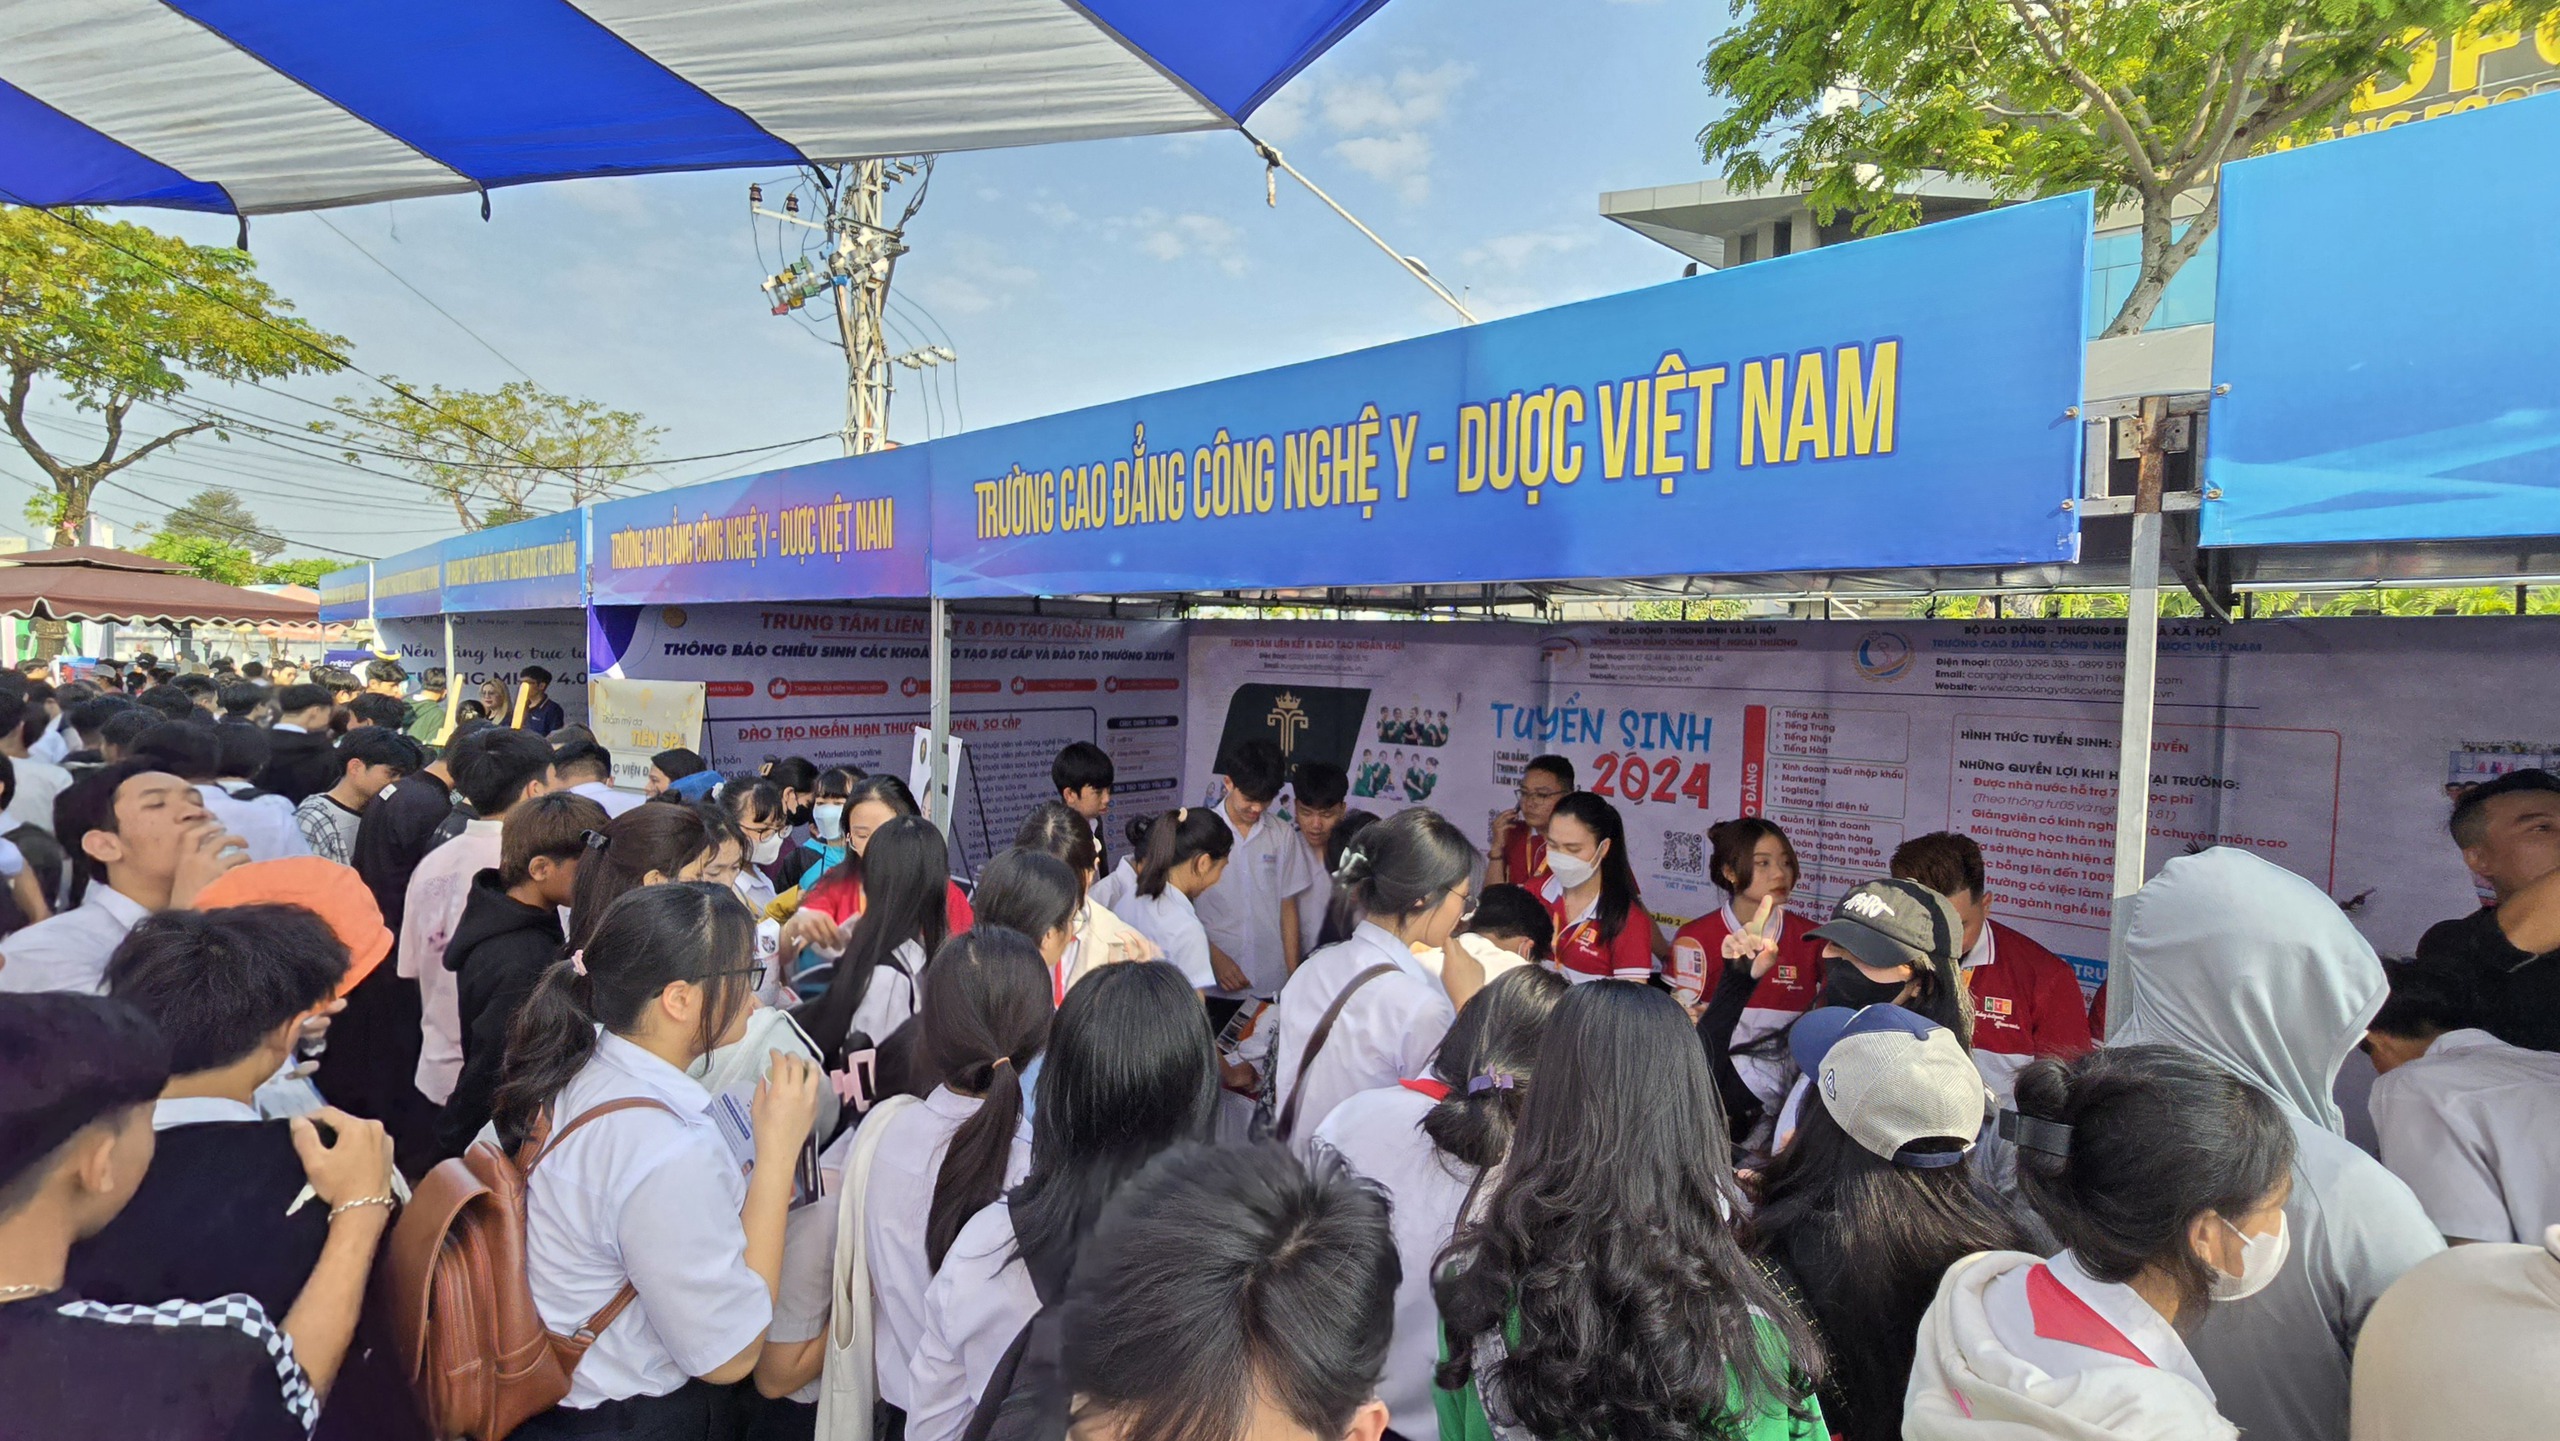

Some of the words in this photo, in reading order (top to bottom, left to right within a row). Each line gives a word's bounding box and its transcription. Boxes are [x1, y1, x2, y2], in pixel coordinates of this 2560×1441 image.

[974, 465, 1055, 539] TRƯỜNG
[1060, 464, 1106, 531] CAO
[1113, 423, 1185, 526] ĐẲNG
[1194, 430, 1275, 518] CÔNG
[1284, 405, 1380, 519] NGHỆ
[1390, 415, 1418, 499] Y
[1428, 446, 1445, 461] -
[1458, 387, 1583, 505] DƯỢC
[1598, 353, 1725, 494] VIỆT
[1740, 340, 1897, 466] NAM
[611, 524, 643, 569] TRƯỜNG
[646, 526, 663, 567] CAO
[665, 505, 693, 565] ĐẲNG
[695, 512, 723, 562] CÔNG
[726, 506, 757, 567] NGHỆ
[760, 512, 769, 558] Y
[780, 505, 816, 565] DƯỢC
[819, 494, 852, 562] VIỆT
[855, 497, 893, 550] NAM
[761, 612, 833, 631] TRUNG
[839, 613, 881, 632] TÂM
[884, 615, 925, 633] LIÊN
[965, 621, 976, 635] &
[1984, 626, 2006, 634] LAO
[2057, 625, 2110, 635] THƯƠNG
[1980, 639, 2007, 648] CAO
[2051, 638, 2088, 649] CÔNG
[402, 643, 436, 658] Nền
[454, 646, 486, 664] ảng
[494, 646, 523, 662] học
[664, 642, 727, 656] THÔNG
[731, 642, 768, 657] BÁO
[772, 643, 817, 658] CHIÊU
[820, 646, 857, 658] SINH
[859, 643, 889, 659] CÁC
[964, 649, 987, 663] TẠO
[1035, 648, 1051, 660] VÀ
[1052, 648, 1076, 661] ĐÀO
[1078, 650, 1099, 664] TẠO
[1993, 659, 2023, 668] (0236)
[557, 672, 588, 685] 4.0
[1935, 671, 1965, 679] Email:
[1935, 682, 1977, 691] Website:
[1490, 691, 1605, 745] TUYỂN
[1619, 707, 1712, 752] SINH
[1785, 710, 1808, 720] Tiếng
[1811, 711, 1829, 720] Anh
[738, 726, 772, 741] ĐÀO
[776, 727, 805, 742] TẠO
[809, 719, 849, 737] NGẮN
[853, 723, 881, 739] HẠN
[1784, 721, 1808, 731] Tiếng
[1810, 723, 1835, 733] Trung
[1784, 732, 1807, 742] Tiếng
[1810, 734, 1831, 743] Nhật
[1961, 730, 1991, 741] HÌNH
[1995, 731, 2029, 742] THỨC
[2033, 732, 2072, 745] TUYỂN
[2077, 738, 2112, 748] SINH:
[1783, 743, 1807, 754] Tiếng
[1809, 745, 1828, 754] Hàn
[1781, 774, 1827, 786] Marketing
[1782, 763, 1800, 772] Kinh
[1802, 764, 1830, 774] doanh
[1832, 765, 1852, 776] xuất
[1854, 769, 1878, 779] nhập
[1959, 760, 2004, 771] NHỮNG
[2009, 761, 2051, 774] QUYỀN
[2056, 766, 2077, 778] LỢI
[2081, 769, 2104, 779] KHI
[2172, 775, 2240, 789] TRƯỜNG:
[1591, 753, 1711, 809] 2024
[1974, 777, 2006, 790] Được
[2008, 780, 2032, 790] nhà
[2035, 781, 2067, 793] nước
[2070, 783, 2087, 795] hỗ
[2089, 787, 2107, 798] trợ
[1781, 785, 1819, 796] Logistics
[1781, 796, 1813, 808] Thương
[1815, 800, 1833, 809] mại
[1835, 801, 1856, 811] điện
[1780, 815, 1804, 824] Quản
[1818, 819, 1837, 828] kinh
[1839, 821, 1870, 831] doanh
[2039, 813, 2055, 825] có
[2058, 816, 2085, 829] kinh
[2163, 827, 2216, 843] chuyên
[2220, 833, 2253, 846] môn
[2256, 838, 2288, 849] cao
[1795, 827, 1820, 837] chính
[1848, 833, 1873, 845] hàng
[1970, 825, 1993, 835] Môi
[1995, 828, 2036, 842] trường
[2038, 831, 2064, 845] học
[2066, 834, 2096, 847] thân
[1815, 841, 1846, 852] doanh
[1848, 845, 1881, 857] nghiệp
[2006, 845, 2034, 857] thực
[2036, 846, 2072, 861] hành
[2072, 852, 2101, 865] hiện
[1848, 857, 1860, 866] tin
[2031, 863, 2051, 876] lên
[2053, 867, 2078, 880] đến
[2082, 870, 2115, 884] 100%
[1986, 875, 2027, 891] trường
[2029, 881, 2045, 893] có
[2048, 884, 2076, 896] việc
[2078, 886, 2104, 899] làm
[1993, 893, 2009, 903] 20
[2011, 896, 2051, 911] ngành
